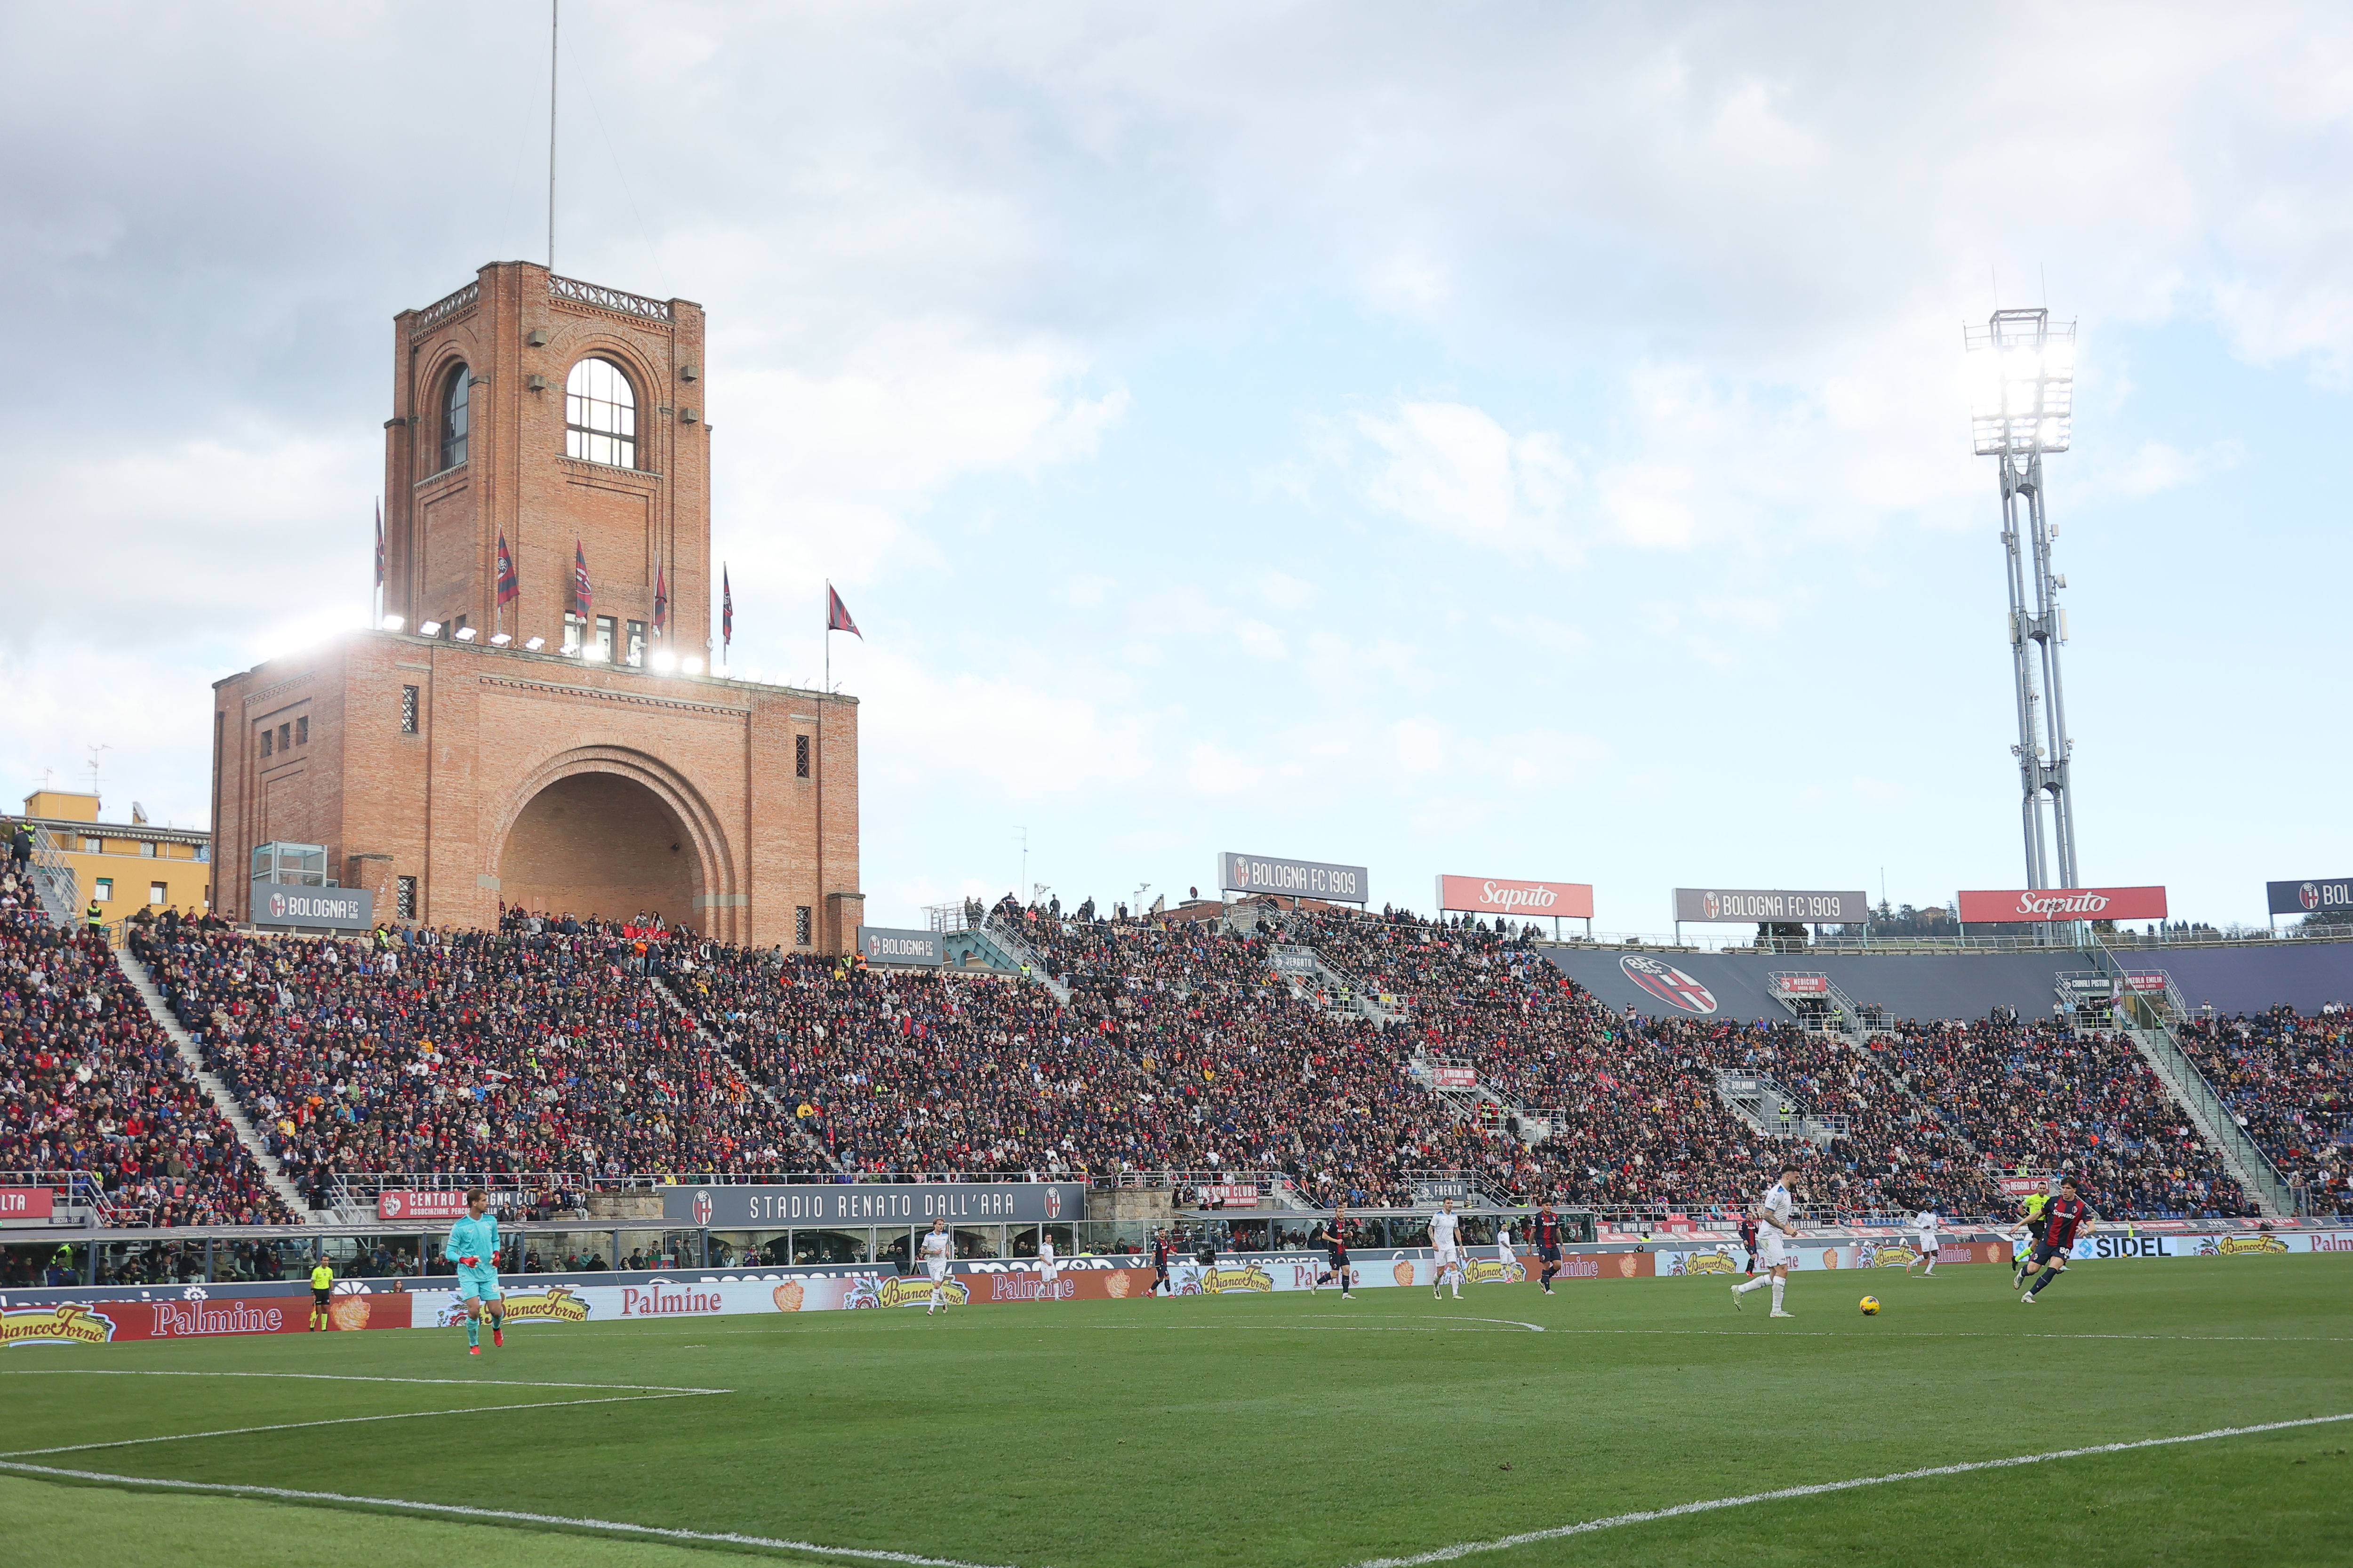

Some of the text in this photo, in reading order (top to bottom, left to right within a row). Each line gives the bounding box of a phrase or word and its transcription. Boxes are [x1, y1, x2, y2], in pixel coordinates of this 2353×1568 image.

[1252, 862, 1356, 894] BOLOGNA FC 1909
[1479, 881, 1558, 912] Saputo
[2322, 884, 2353, 905] BOL
[289, 896, 359, 919] BOLOGNA FC
[1722, 895, 1841, 917] BOLOGNA FC 1909
[2016, 891, 2111, 920] Saputo
[882, 938, 933, 956] BOLOGNA FC
[1625, 957, 1662, 969] BFC
[2091, 979, 2110, 987] PISTOIA
[1233, 1186, 1257, 1197] CLUBS
[1434, 1184, 1462, 1196] FAENZA
[2010, 1181, 2029, 1191] REGGIO
[0, 1194, 25, 1211] LTA
[409, 1192, 460, 1207] CENTRO
[462, 1192, 511, 1206] BGNA
[750, 1193, 1014, 1219] STADIO RENATO DALL'ARA
[2052, 1209, 2076, 1220] Saputo
[1623, 1223, 1652, 1232] ARPAD WEISZ
[1671, 1224, 1689, 1232] RIMINI
[1790, 1220, 1821, 1229] CALDERARA
[1937, 1243, 1971, 1263] almine
[2059, 1247, 2070, 1256] 80
[2097, 1237, 2172, 1258] SIDEL
[621, 1285, 722, 1316] Palmine
[0, 1304, 105, 1343] iancoForno
[151, 1300, 282, 1336] Palmine
